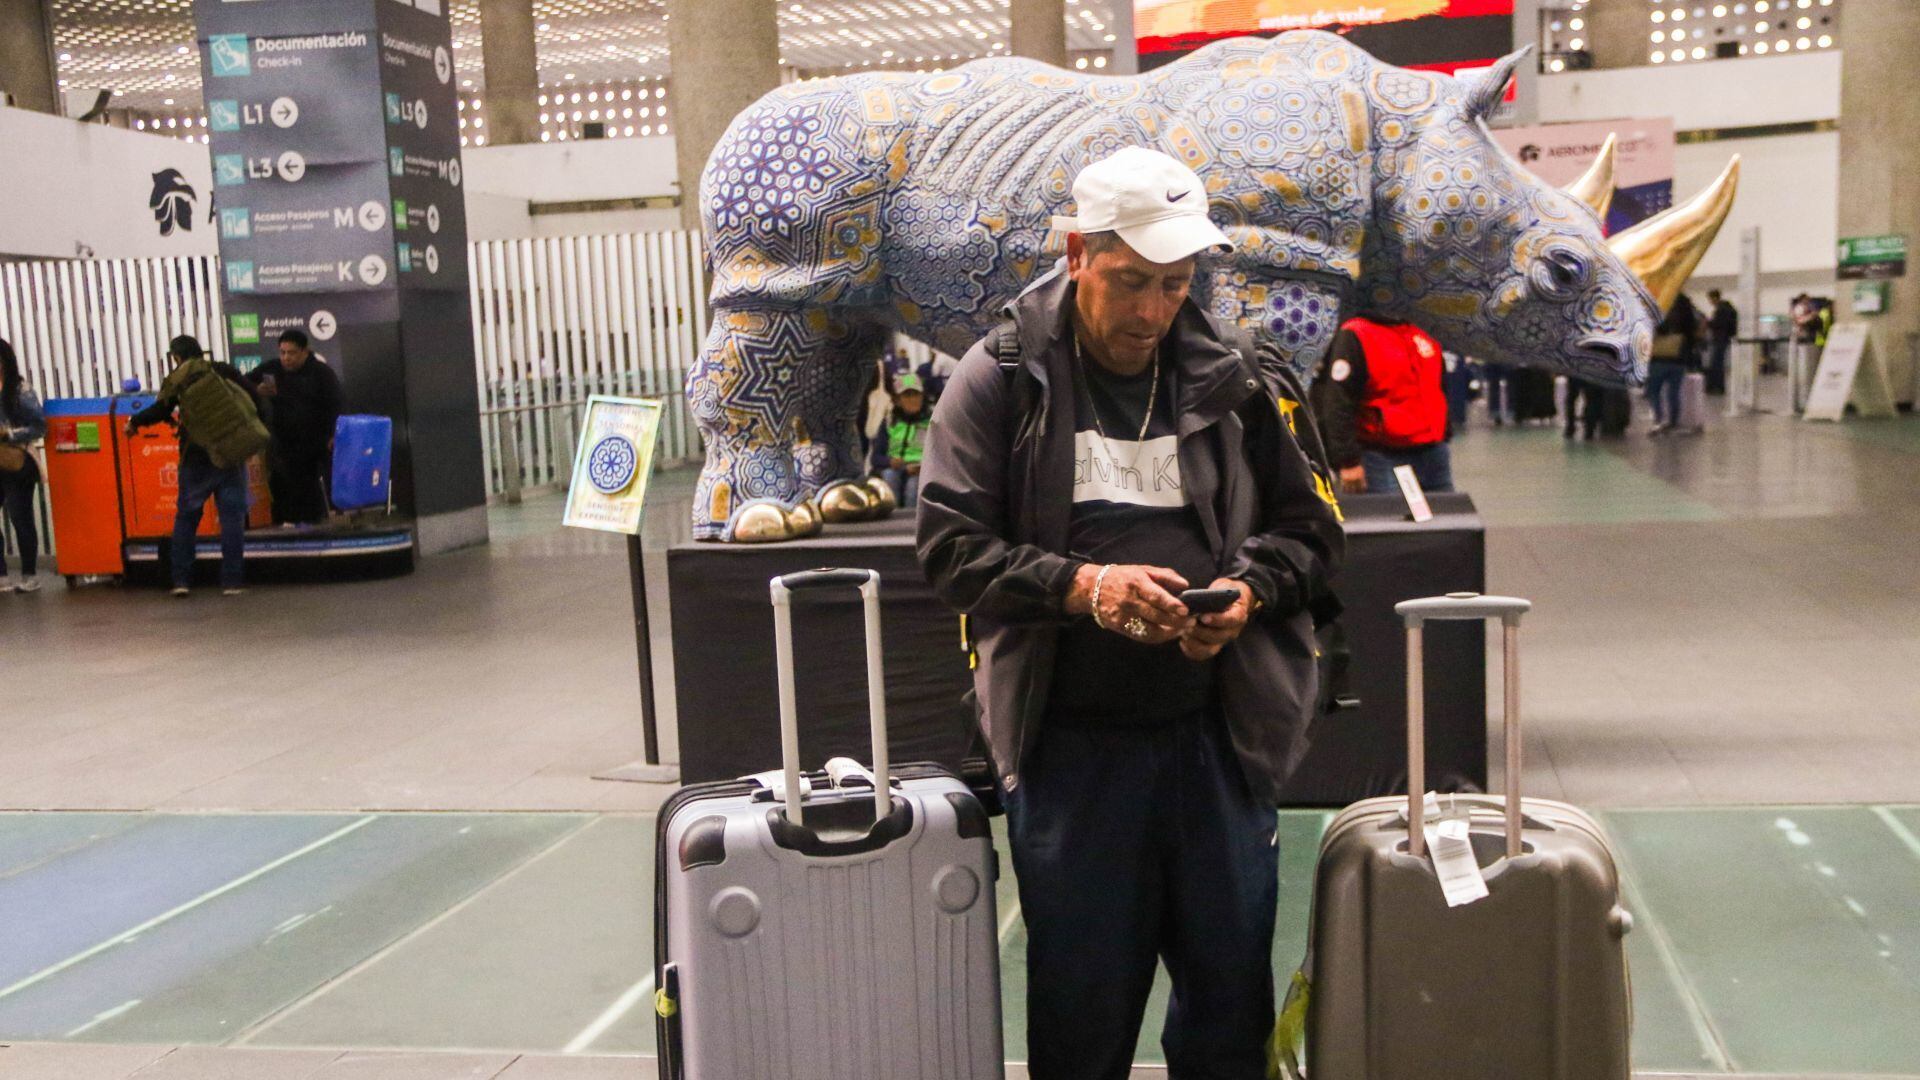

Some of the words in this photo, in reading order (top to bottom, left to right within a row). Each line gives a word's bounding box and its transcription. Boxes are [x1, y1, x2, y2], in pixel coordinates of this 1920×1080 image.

[1311, 10, 1335, 25] de
[255, 31, 366, 51] Documentación
[257, 55, 302, 68] Check-in
[244, 104, 263, 125] L1
[401, 101, 414, 122] L3
[1548, 140, 1636, 157] AEROMECO
[249, 157, 273, 179] L3
[438, 159, 448, 180] M
[254, 212, 286, 222] Acceso
[287, 210, 330, 221] Pasajeros
[333, 206, 354, 229] M
[258, 265, 290, 275] Acceso
[291, 263, 334, 274] Pasajeros
[338, 260, 354, 283] K
[263, 316, 304, 328] Aerotrén
[1075, 447, 1143, 492] alvin
[1153, 454, 1181, 492] K
